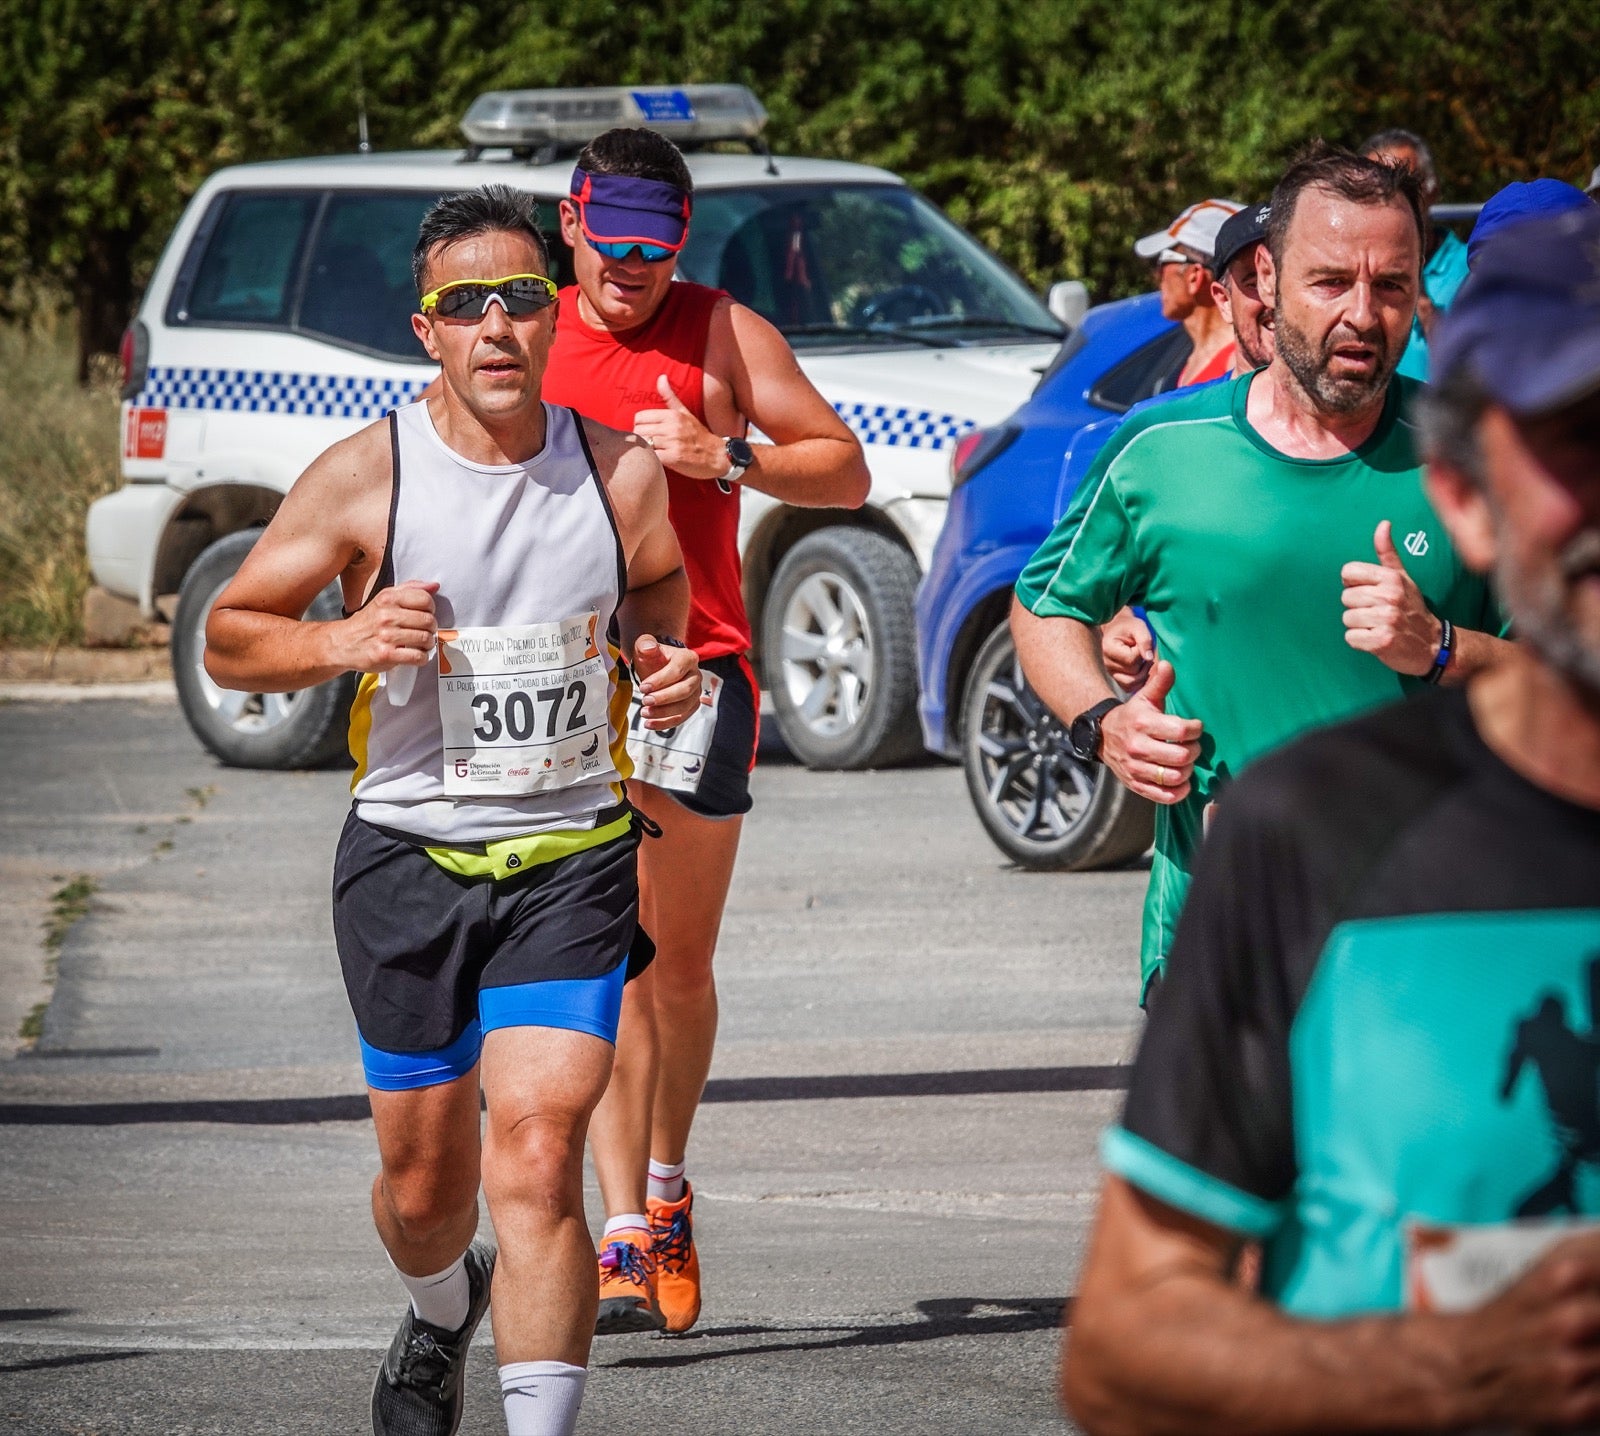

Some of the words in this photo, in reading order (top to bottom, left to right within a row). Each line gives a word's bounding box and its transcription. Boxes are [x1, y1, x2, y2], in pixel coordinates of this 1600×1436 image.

[460, 639, 482, 653] XXXV
[484, 638, 505, 653] GRAN
[507, 637, 536, 652] PREMIO
[539, 636, 550, 649] DE
[503, 654, 536, 666] UNIVERSO
[538, 651, 560, 663] LORCA
[456, 680, 480, 692] PRUEBA
[491, 679, 512, 690] FONDO
[541, 676, 550, 687] DE
[470, 680, 587, 742] 3072
